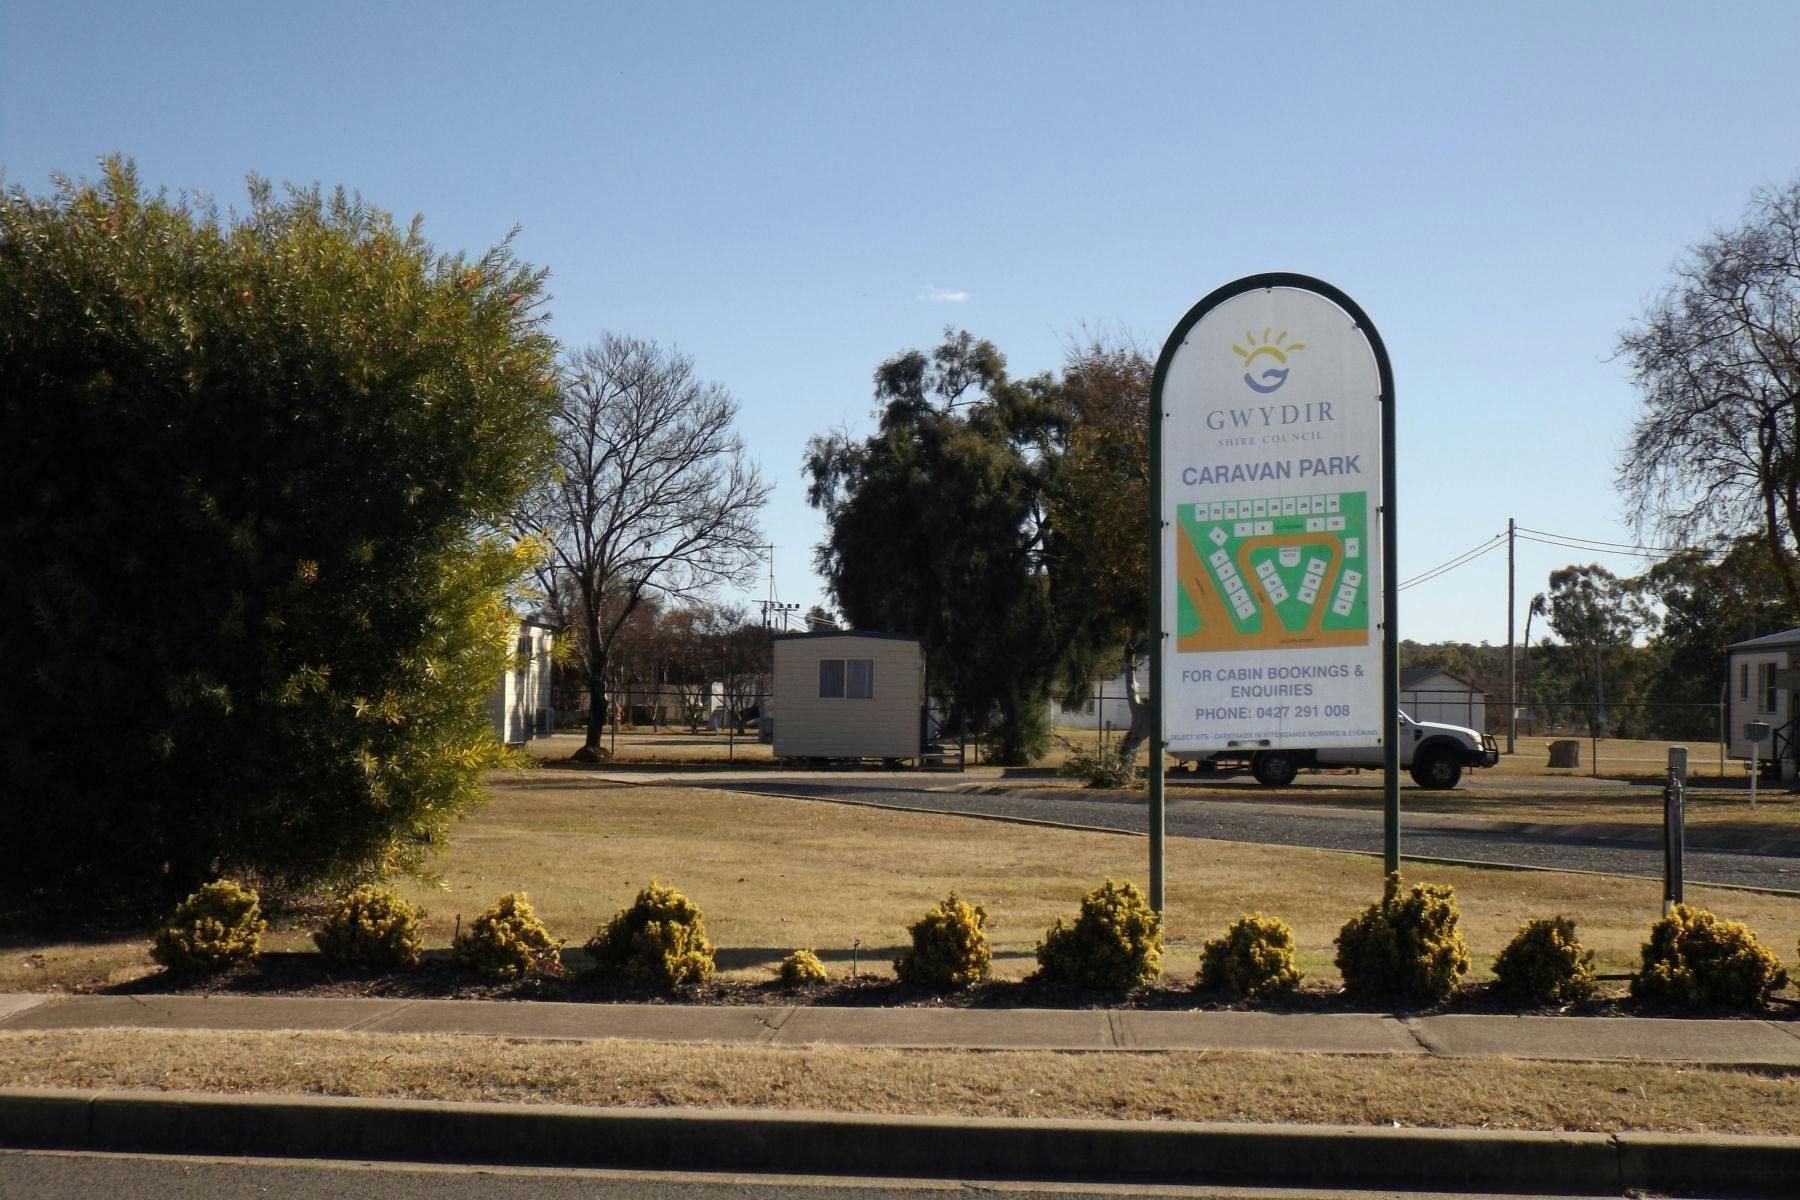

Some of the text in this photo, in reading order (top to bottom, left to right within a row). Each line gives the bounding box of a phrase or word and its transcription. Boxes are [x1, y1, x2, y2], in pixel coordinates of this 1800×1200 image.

[1206, 401, 1335, 430] GWYDIR
[1217, 431, 1323, 447] SHIRE COUNCIL
[1182, 455, 1361, 486] CARAVAN PARK
[1182, 664, 1364, 683] FOR CABIN BOOKINGS &
[1231, 683, 1313, 698] ENQUIRIES
[1195, 704, 1350, 720] PHONE: 0427 291 008
